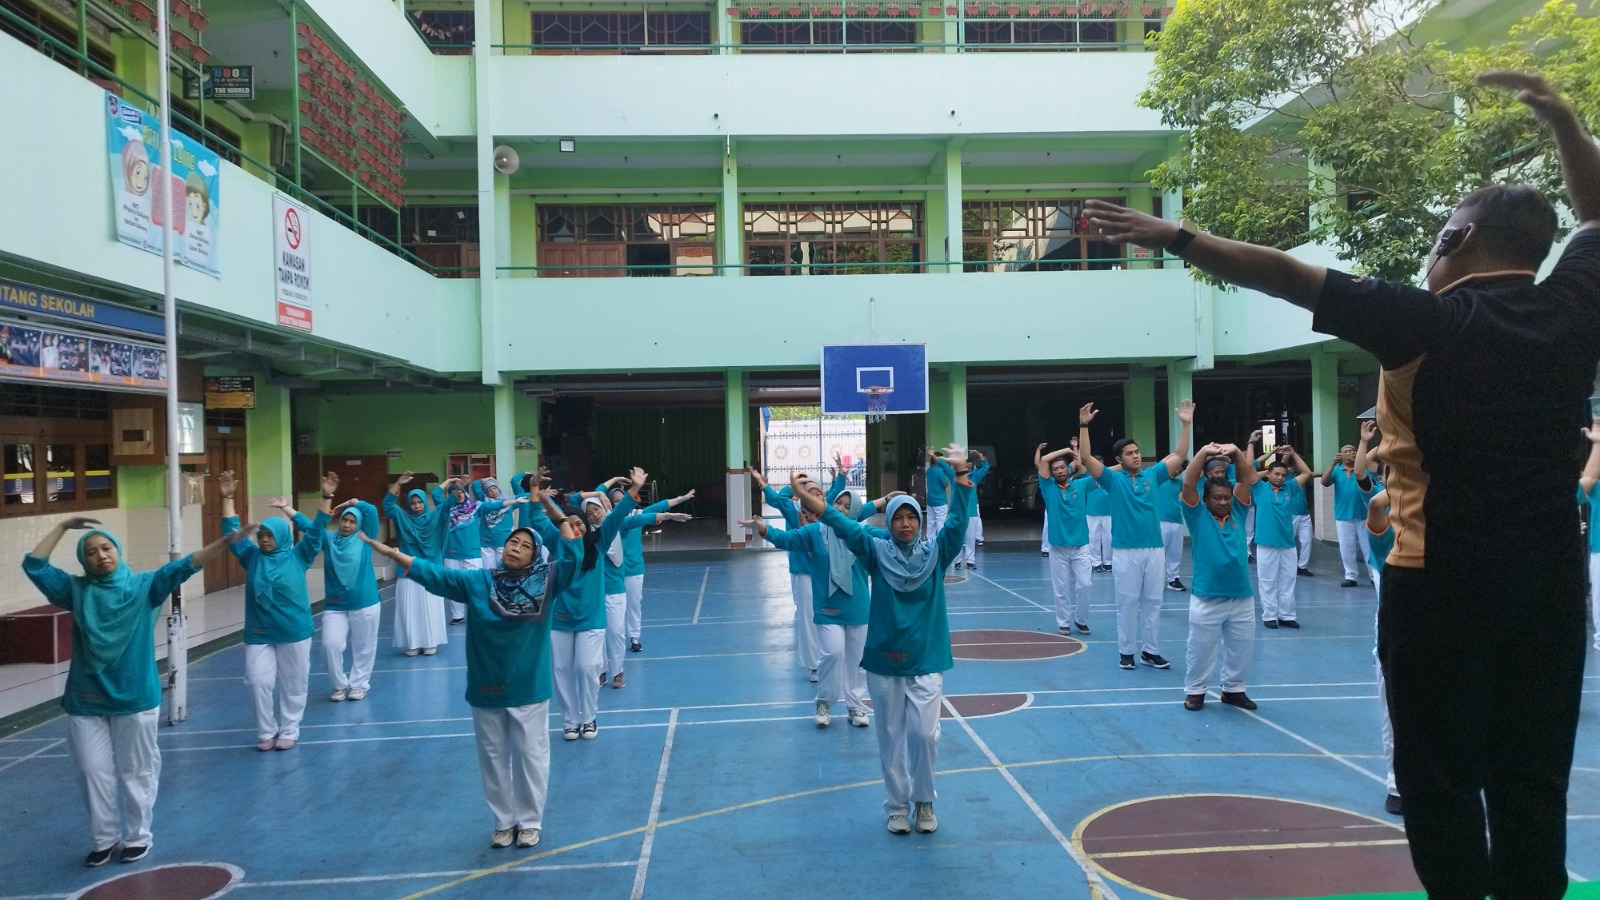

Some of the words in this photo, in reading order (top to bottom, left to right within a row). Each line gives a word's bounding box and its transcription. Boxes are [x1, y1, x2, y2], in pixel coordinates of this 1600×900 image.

[214, 68, 249, 78] BOOK
[282, 251, 305, 272] KAWASAN
[278, 267, 293, 284] TANPA
[294, 272, 310, 290] ROKOK
[40, 293, 95, 319] SEKOLAH
